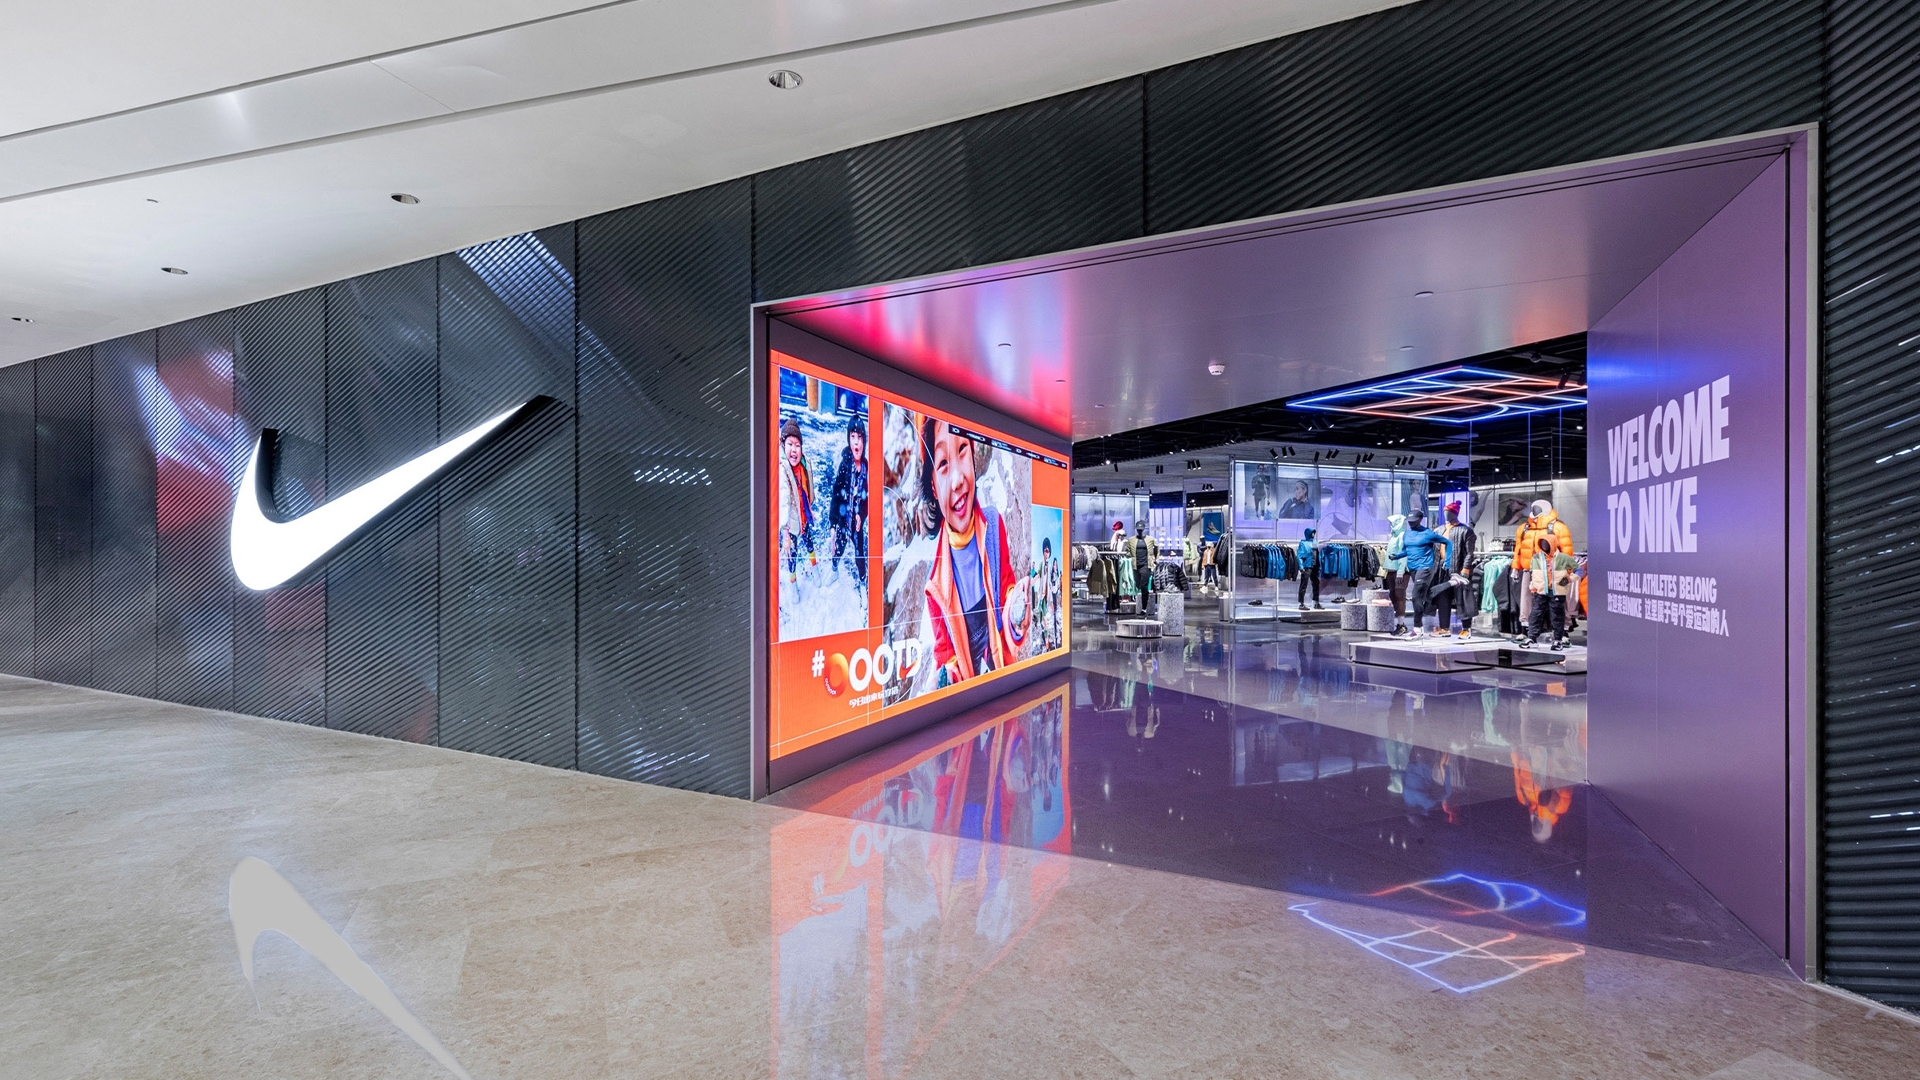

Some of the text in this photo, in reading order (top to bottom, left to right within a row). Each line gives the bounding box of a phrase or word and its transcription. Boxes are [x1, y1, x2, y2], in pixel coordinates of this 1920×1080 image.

[1607, 375, 1730, 487] WELCOME
[1607, 476, 1698, 554] TO NIKE
[1607, 571, 1718, 604] WHERE ALL ATHLETES BELONG
[1607, 592, 1730, 637] 欢迎来到NIKE 这里属于每个爱运动的人
